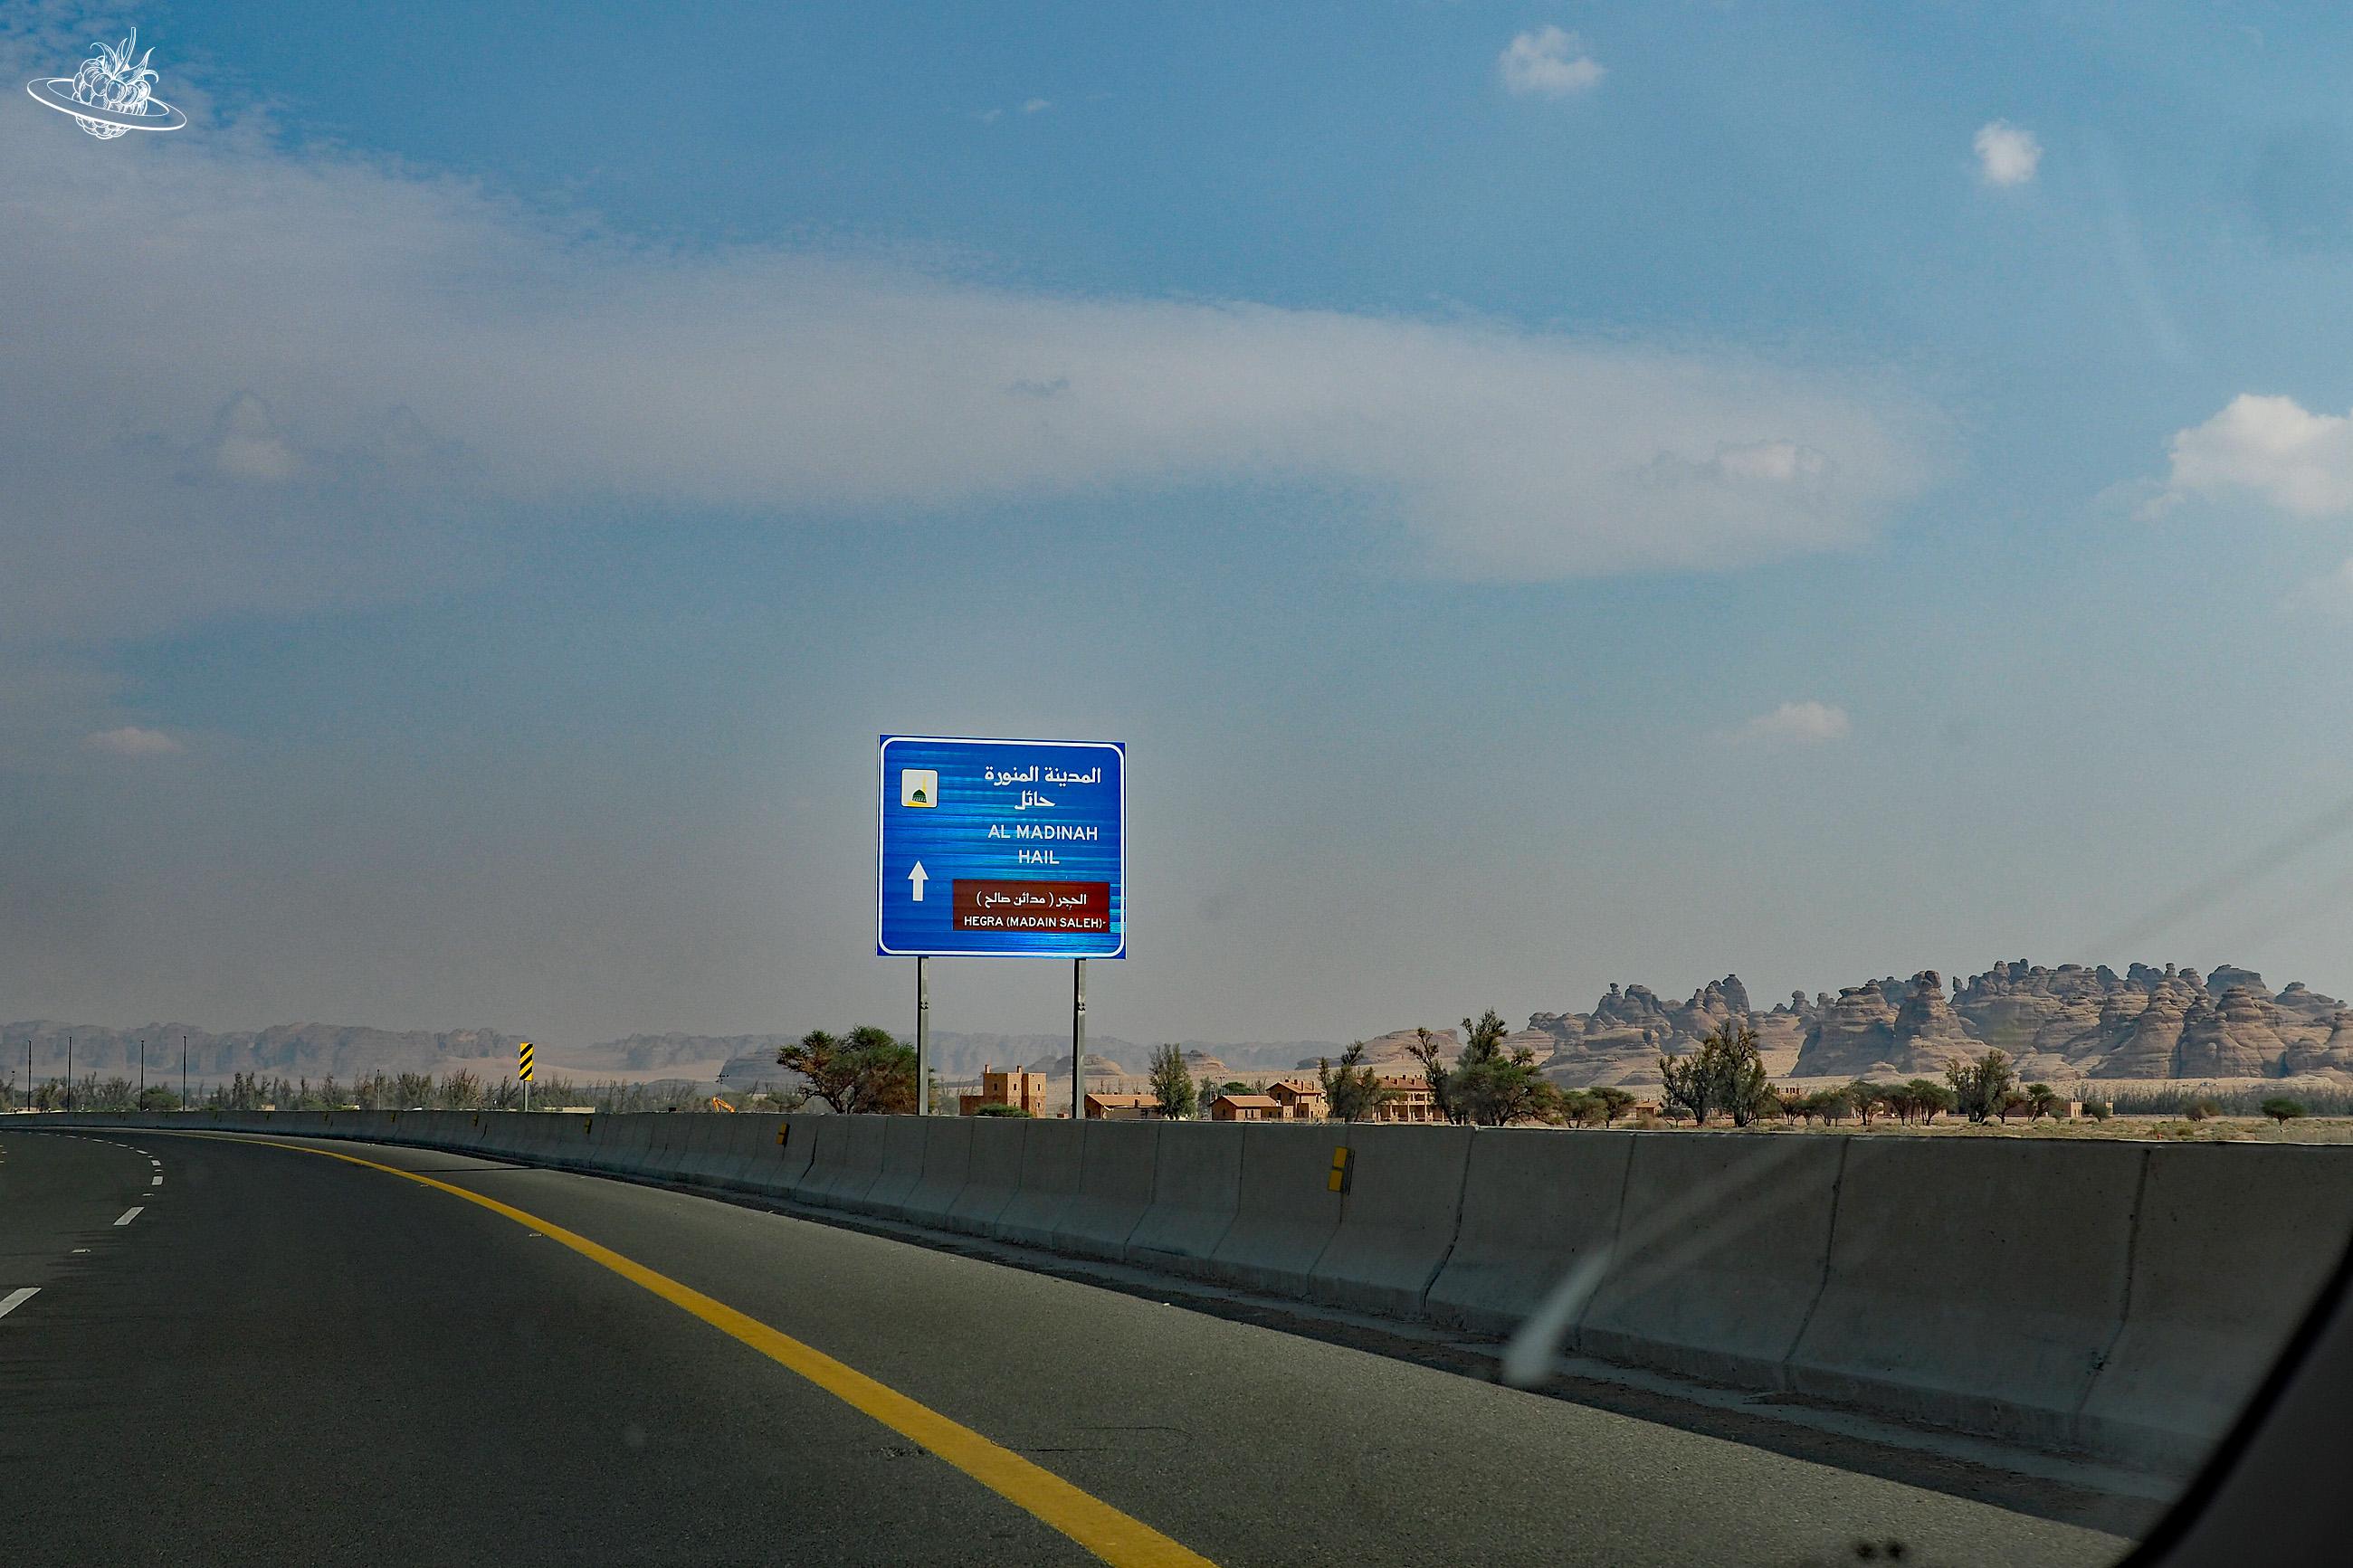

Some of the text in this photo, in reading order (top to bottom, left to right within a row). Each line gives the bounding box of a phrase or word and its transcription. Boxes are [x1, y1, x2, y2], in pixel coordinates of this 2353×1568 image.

[985, 765, 1101, 787] المدينة المنورة
[1014, 790, 1056, 810] حائل
[987, 824, 1098, 841] AL MADINAH
[1018, 850, 1060, 865] HAIL
[1055, 893, 1087, 910] الحجر
[964, 916, 1004, 927] HEGRA
[1006, 916, 1057, 927] (MADAIN
